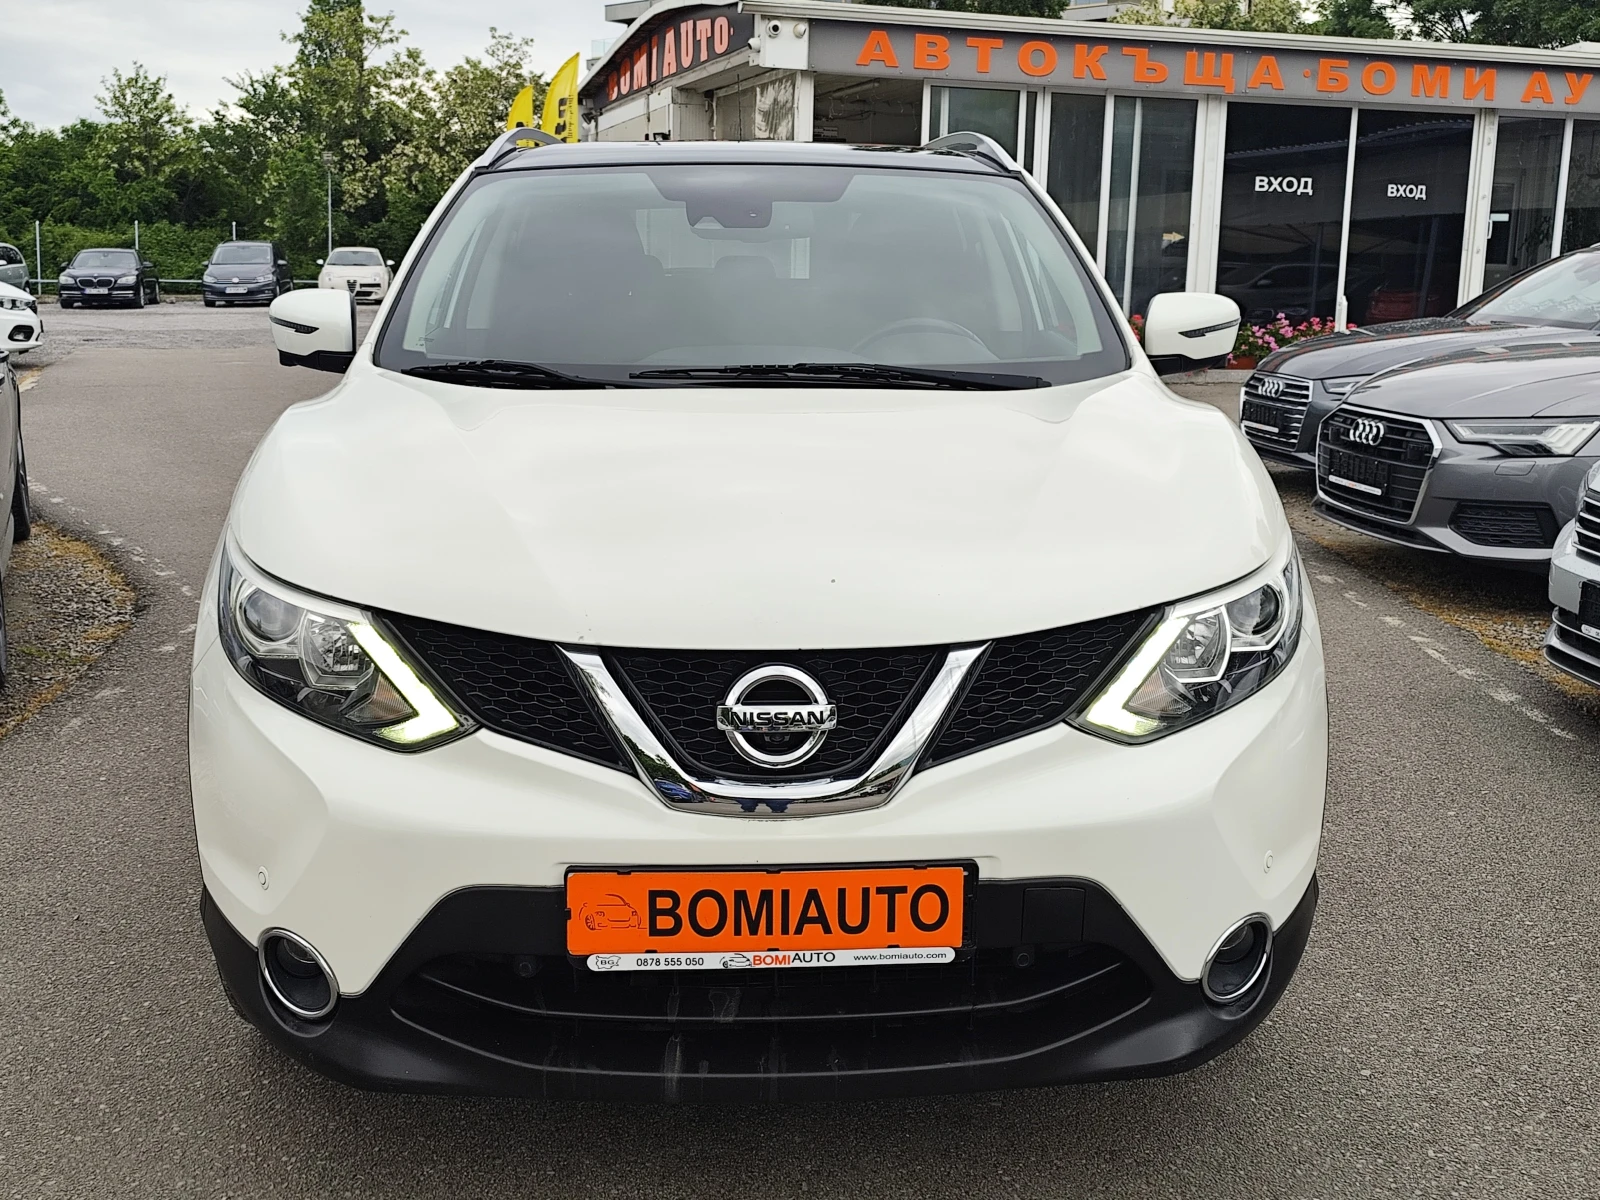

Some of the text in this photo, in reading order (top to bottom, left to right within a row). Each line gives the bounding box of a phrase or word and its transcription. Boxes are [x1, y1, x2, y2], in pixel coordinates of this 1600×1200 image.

[855, 30, 1285, 94] АВТОКЪЩА
[1254, 175, 1313, 196] ВХОД
[1387, 183, 1427, 200] ВХОД
[730, 711, 825, 726] NISSAN
[648, 884, 950, 938] BOMIAUTO
[636, 958, 661, 967] 0878
[664, 957, 682, 966] 555
[685, 957, 705, 966] 050
[853, 951, 947, 961] www.bomiauto.com
